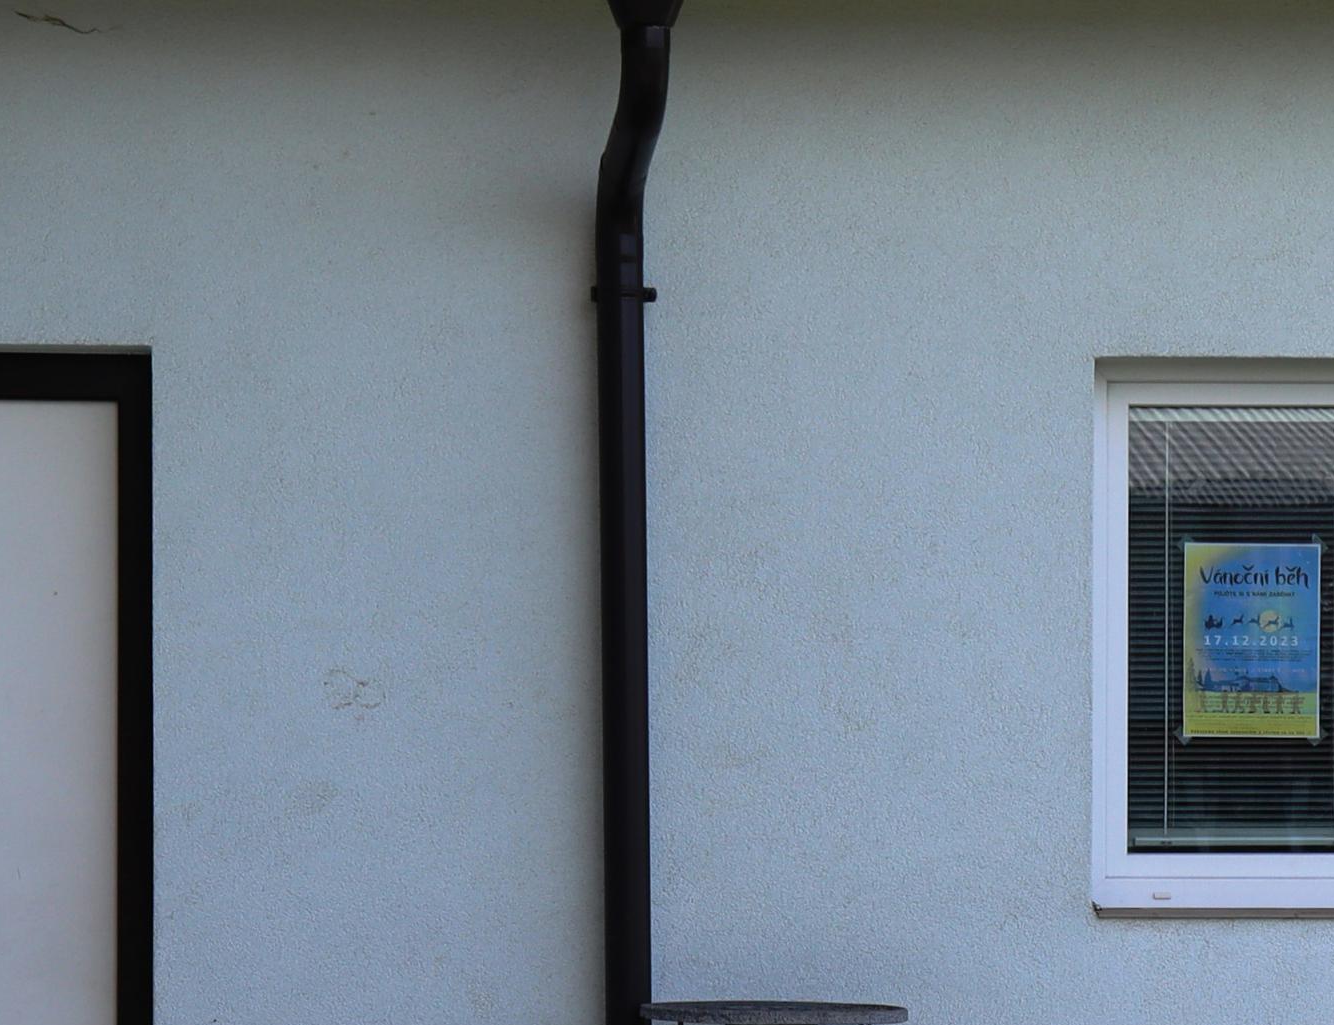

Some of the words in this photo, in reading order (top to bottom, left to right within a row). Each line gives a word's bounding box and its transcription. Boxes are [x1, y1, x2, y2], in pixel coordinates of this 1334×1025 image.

[1200, 564, 1269, 587] Vánoční
[1275, 565, 1310, 589] běh
[1204, 635, 1299, 647] 17.12.2023
